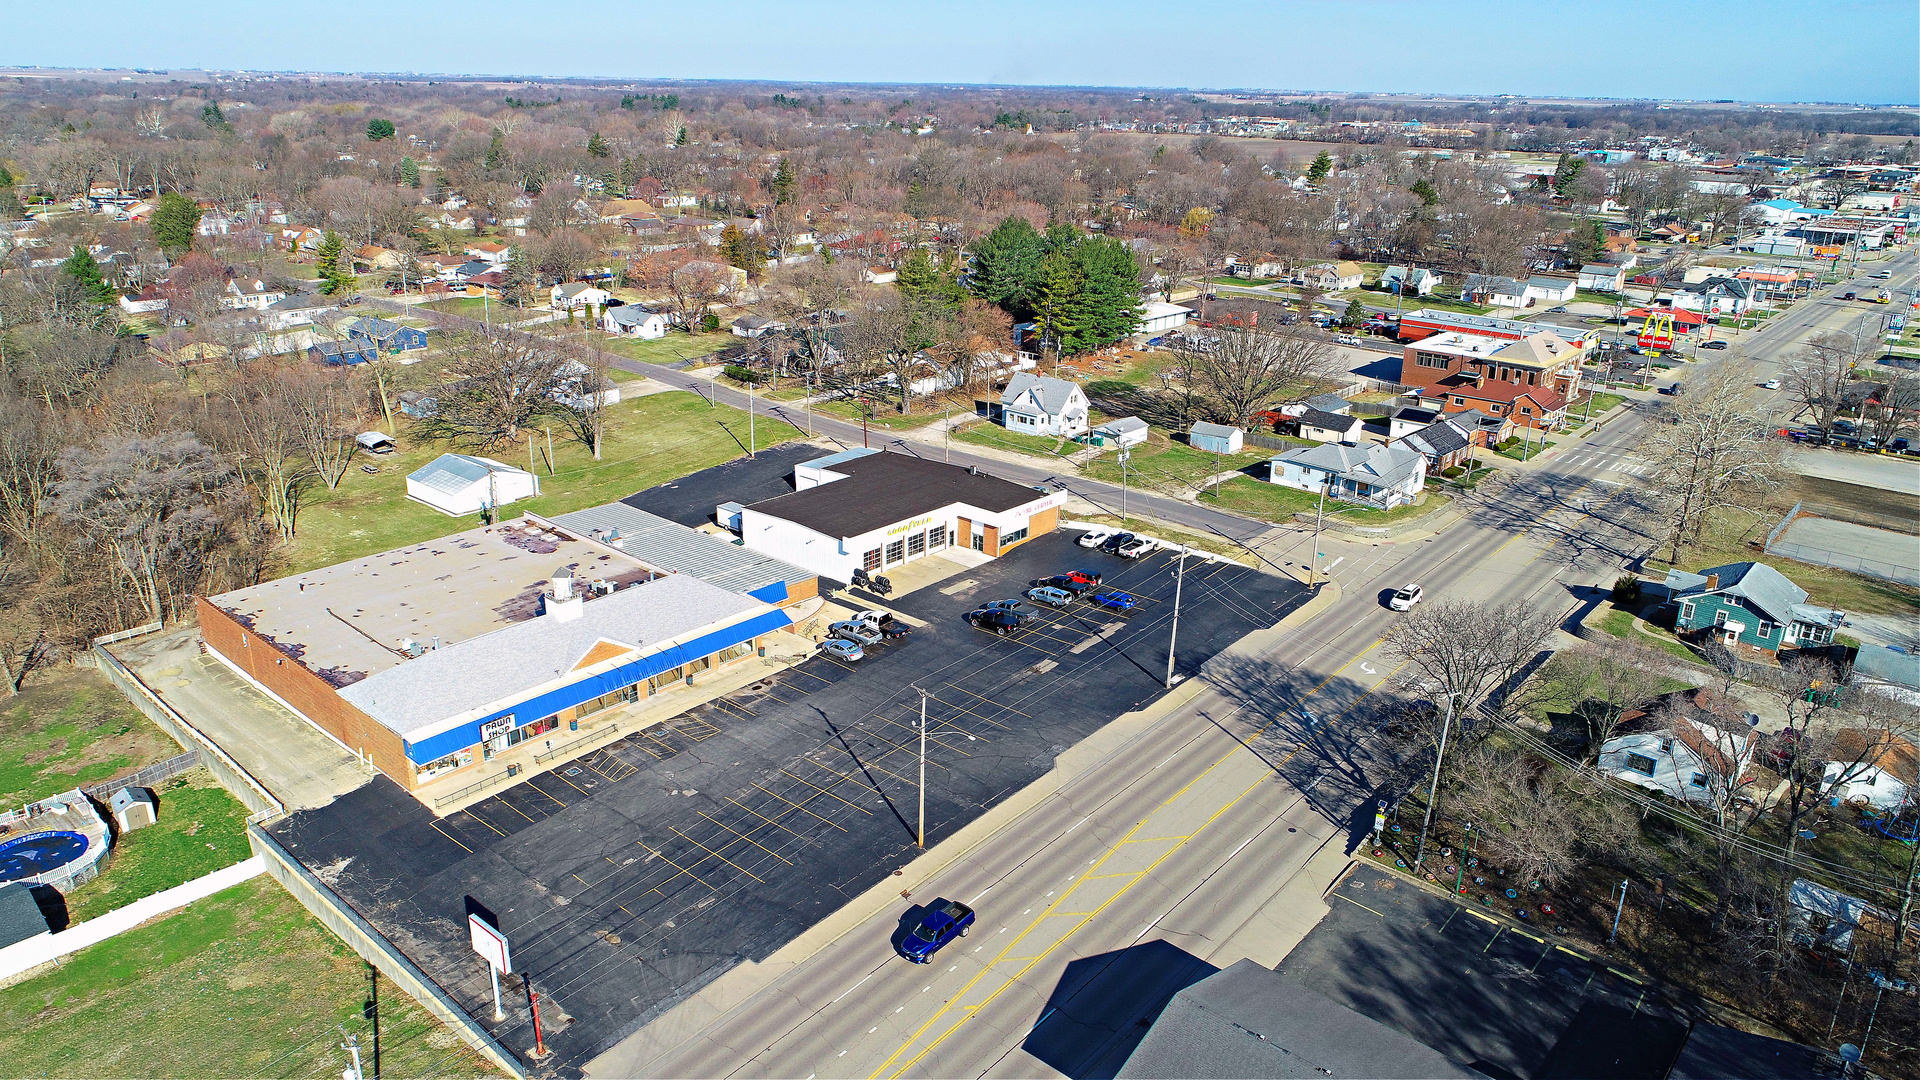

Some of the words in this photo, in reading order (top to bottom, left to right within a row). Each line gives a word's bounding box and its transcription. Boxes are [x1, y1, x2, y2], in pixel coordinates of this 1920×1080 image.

[1638, 337, 1671, 346] McDnald's
[485, 716, 511, 732] PAWN
[488, 725, 510, 740] SHOP
